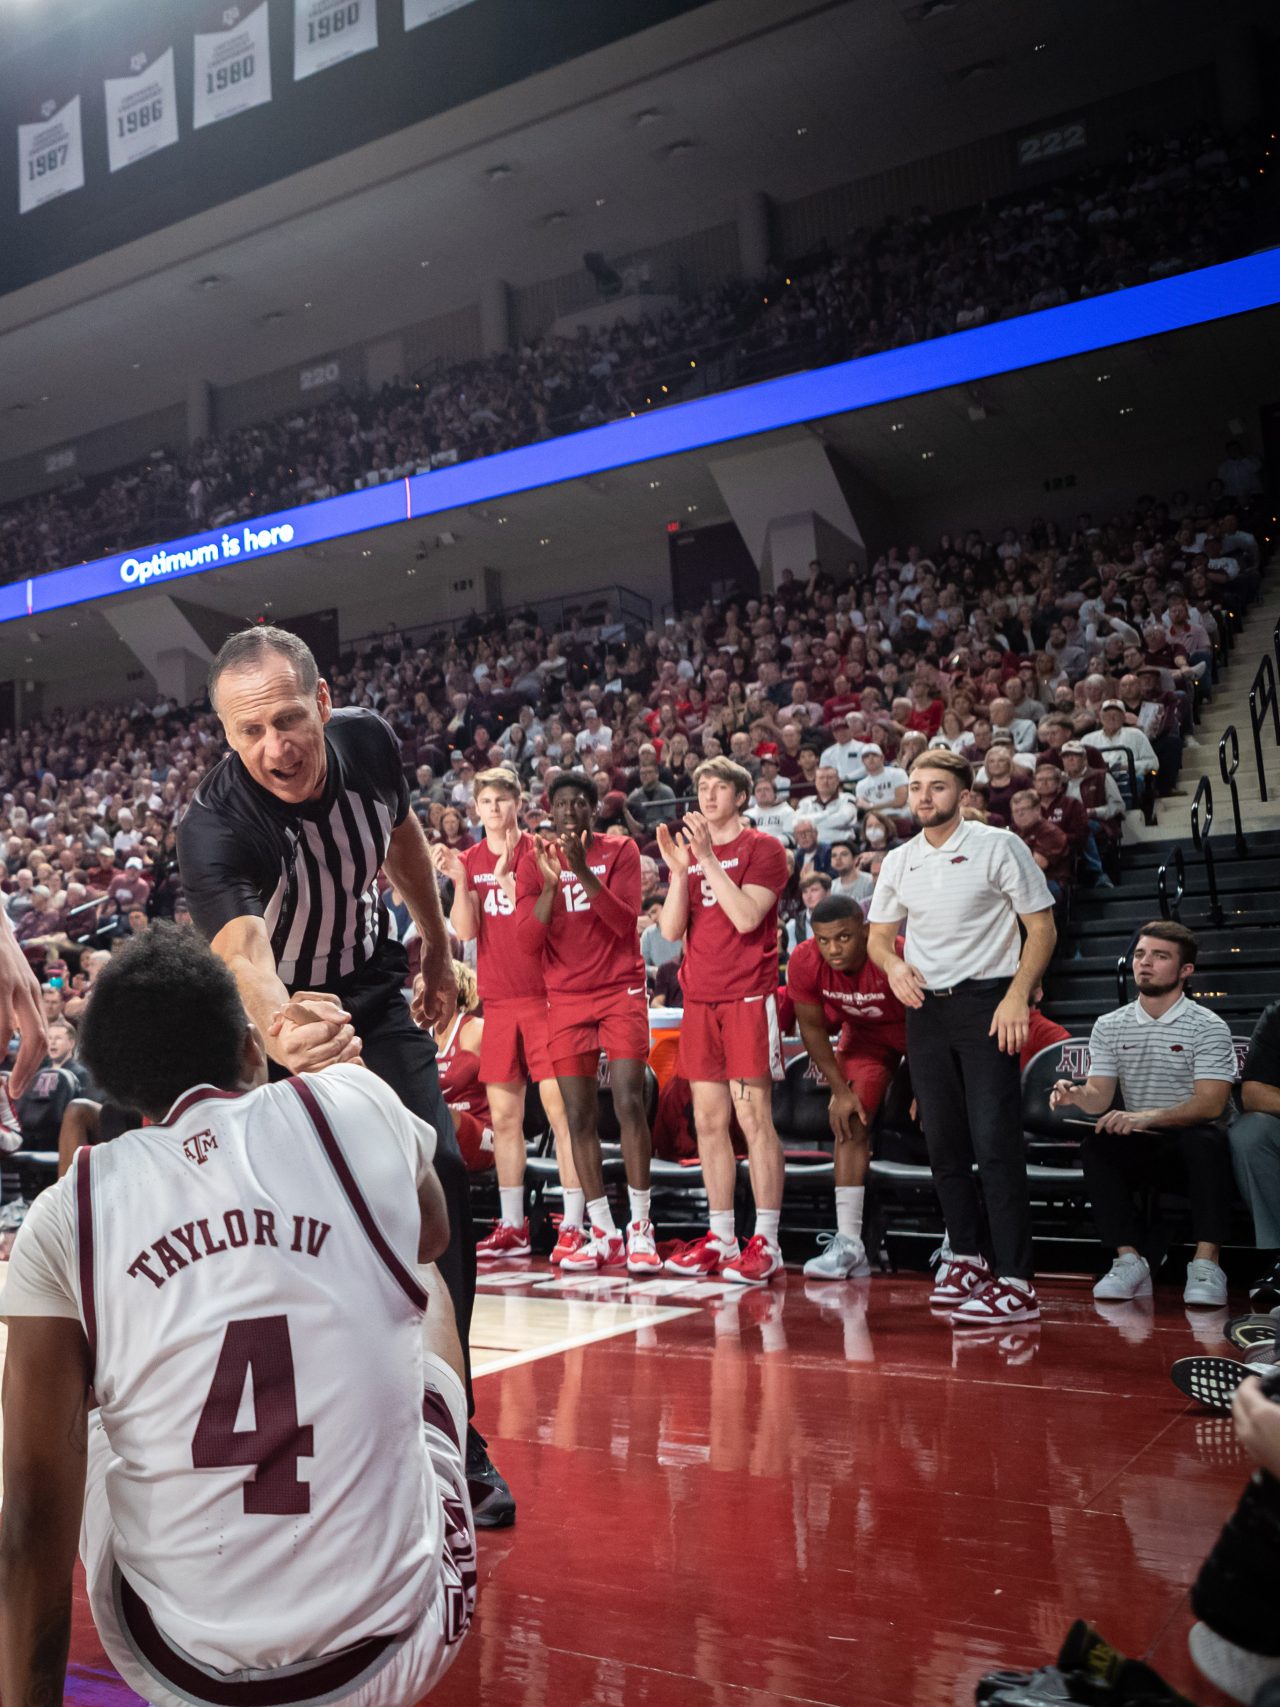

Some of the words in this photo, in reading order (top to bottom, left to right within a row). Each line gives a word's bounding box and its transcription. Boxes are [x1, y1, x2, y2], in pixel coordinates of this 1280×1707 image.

[308, 2, 360, 45] 1980
[206, 54, 255, 95] 1980
[117, 98, 164, 139] 1986
[27, 143, 69, 182] 1987
[1020, 125, 1086, 162] 222
[120, 544, 220, 584] Optimum
[222, 533, 241, 558] is
[243, 524, 295, 553] here
[483, 888, 515, 917] 45
[562, 882, 591, 913] 12
[127, 1208, 279, 1289] TAYLOR
[290, 1214, 332, 1258] IV
[191, 1314, 315, 1515] 4
